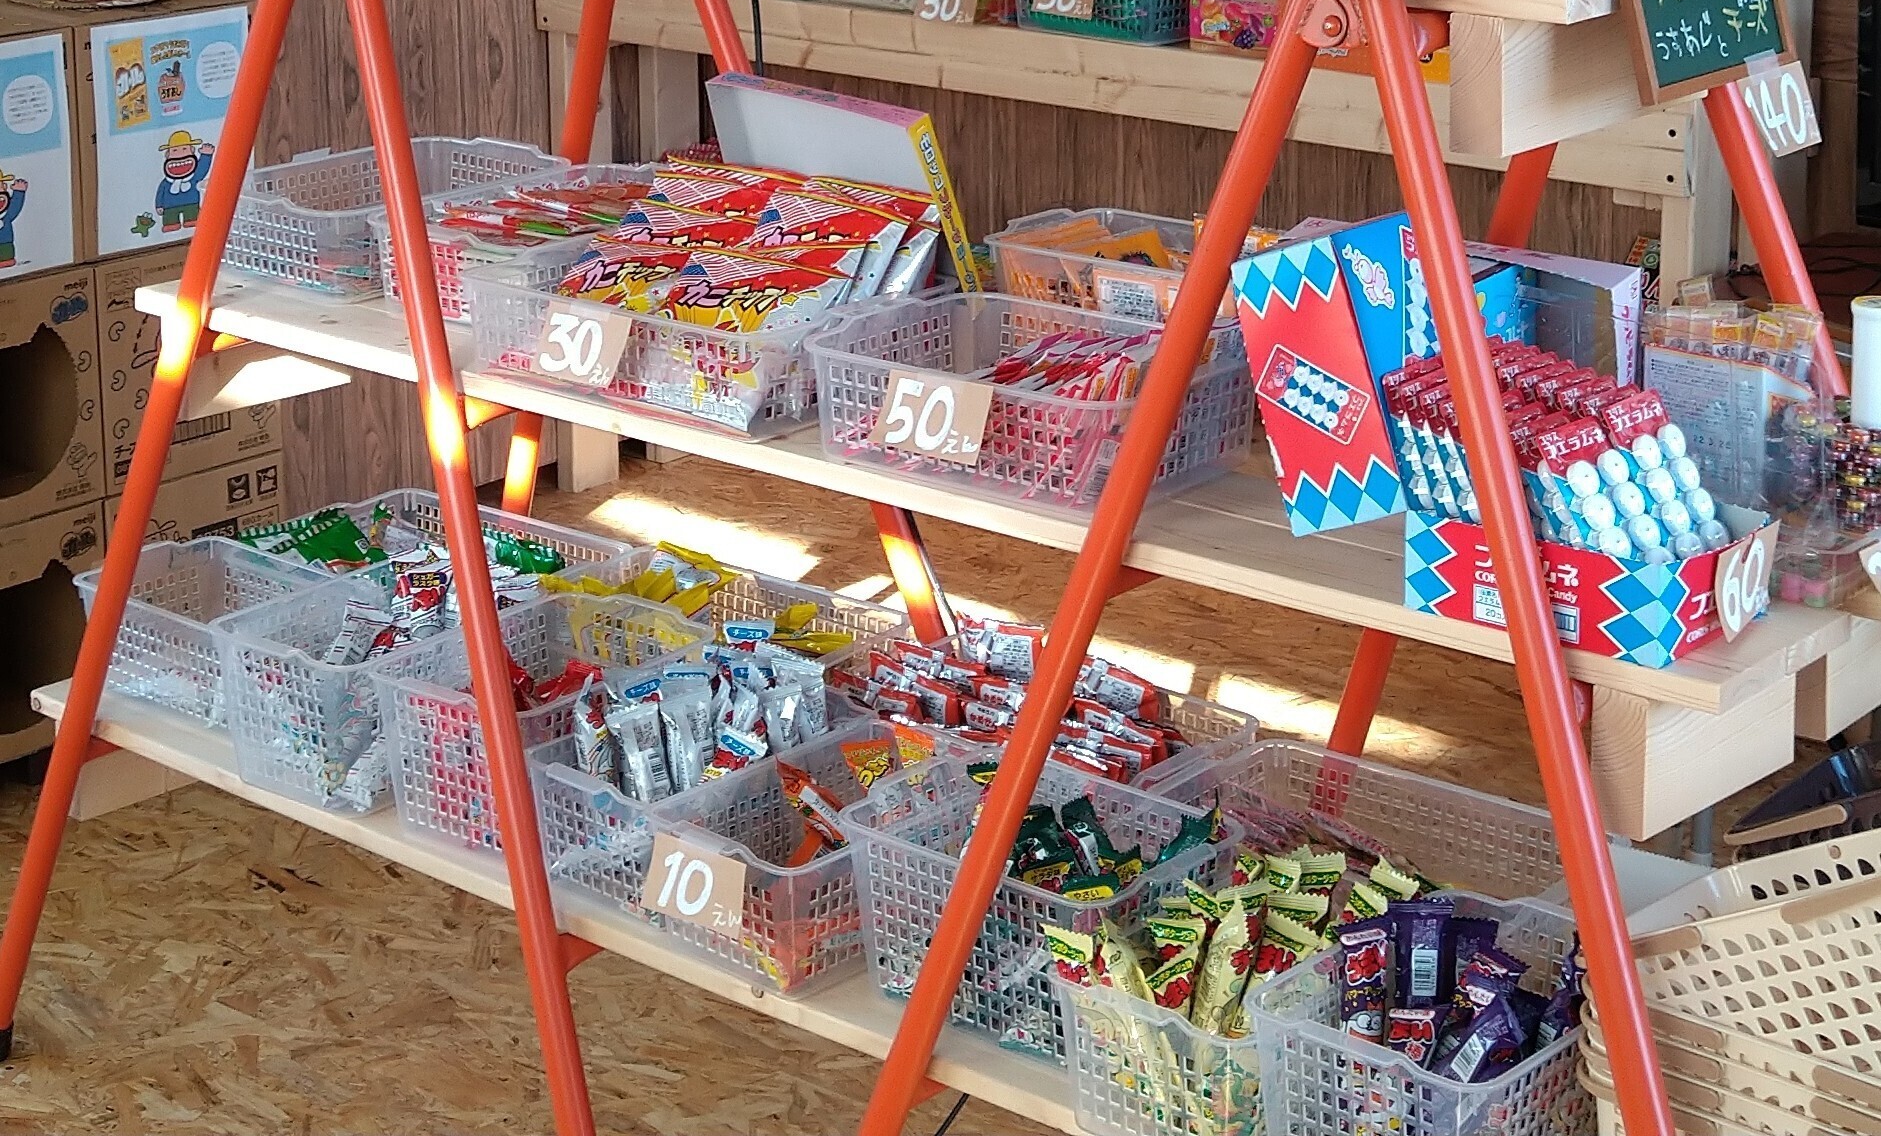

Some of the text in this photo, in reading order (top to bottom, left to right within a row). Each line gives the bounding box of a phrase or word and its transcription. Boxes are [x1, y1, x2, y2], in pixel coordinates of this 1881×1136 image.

[578, 259, 676, 294] カニチップ
[677, 279, 788, 317] カニチップ
[1610, 397, 1666, 434] フエラムネ
[1543, 426, 1609, 461] フエラムネ
[1072, 889, 1101, 900] やさい
